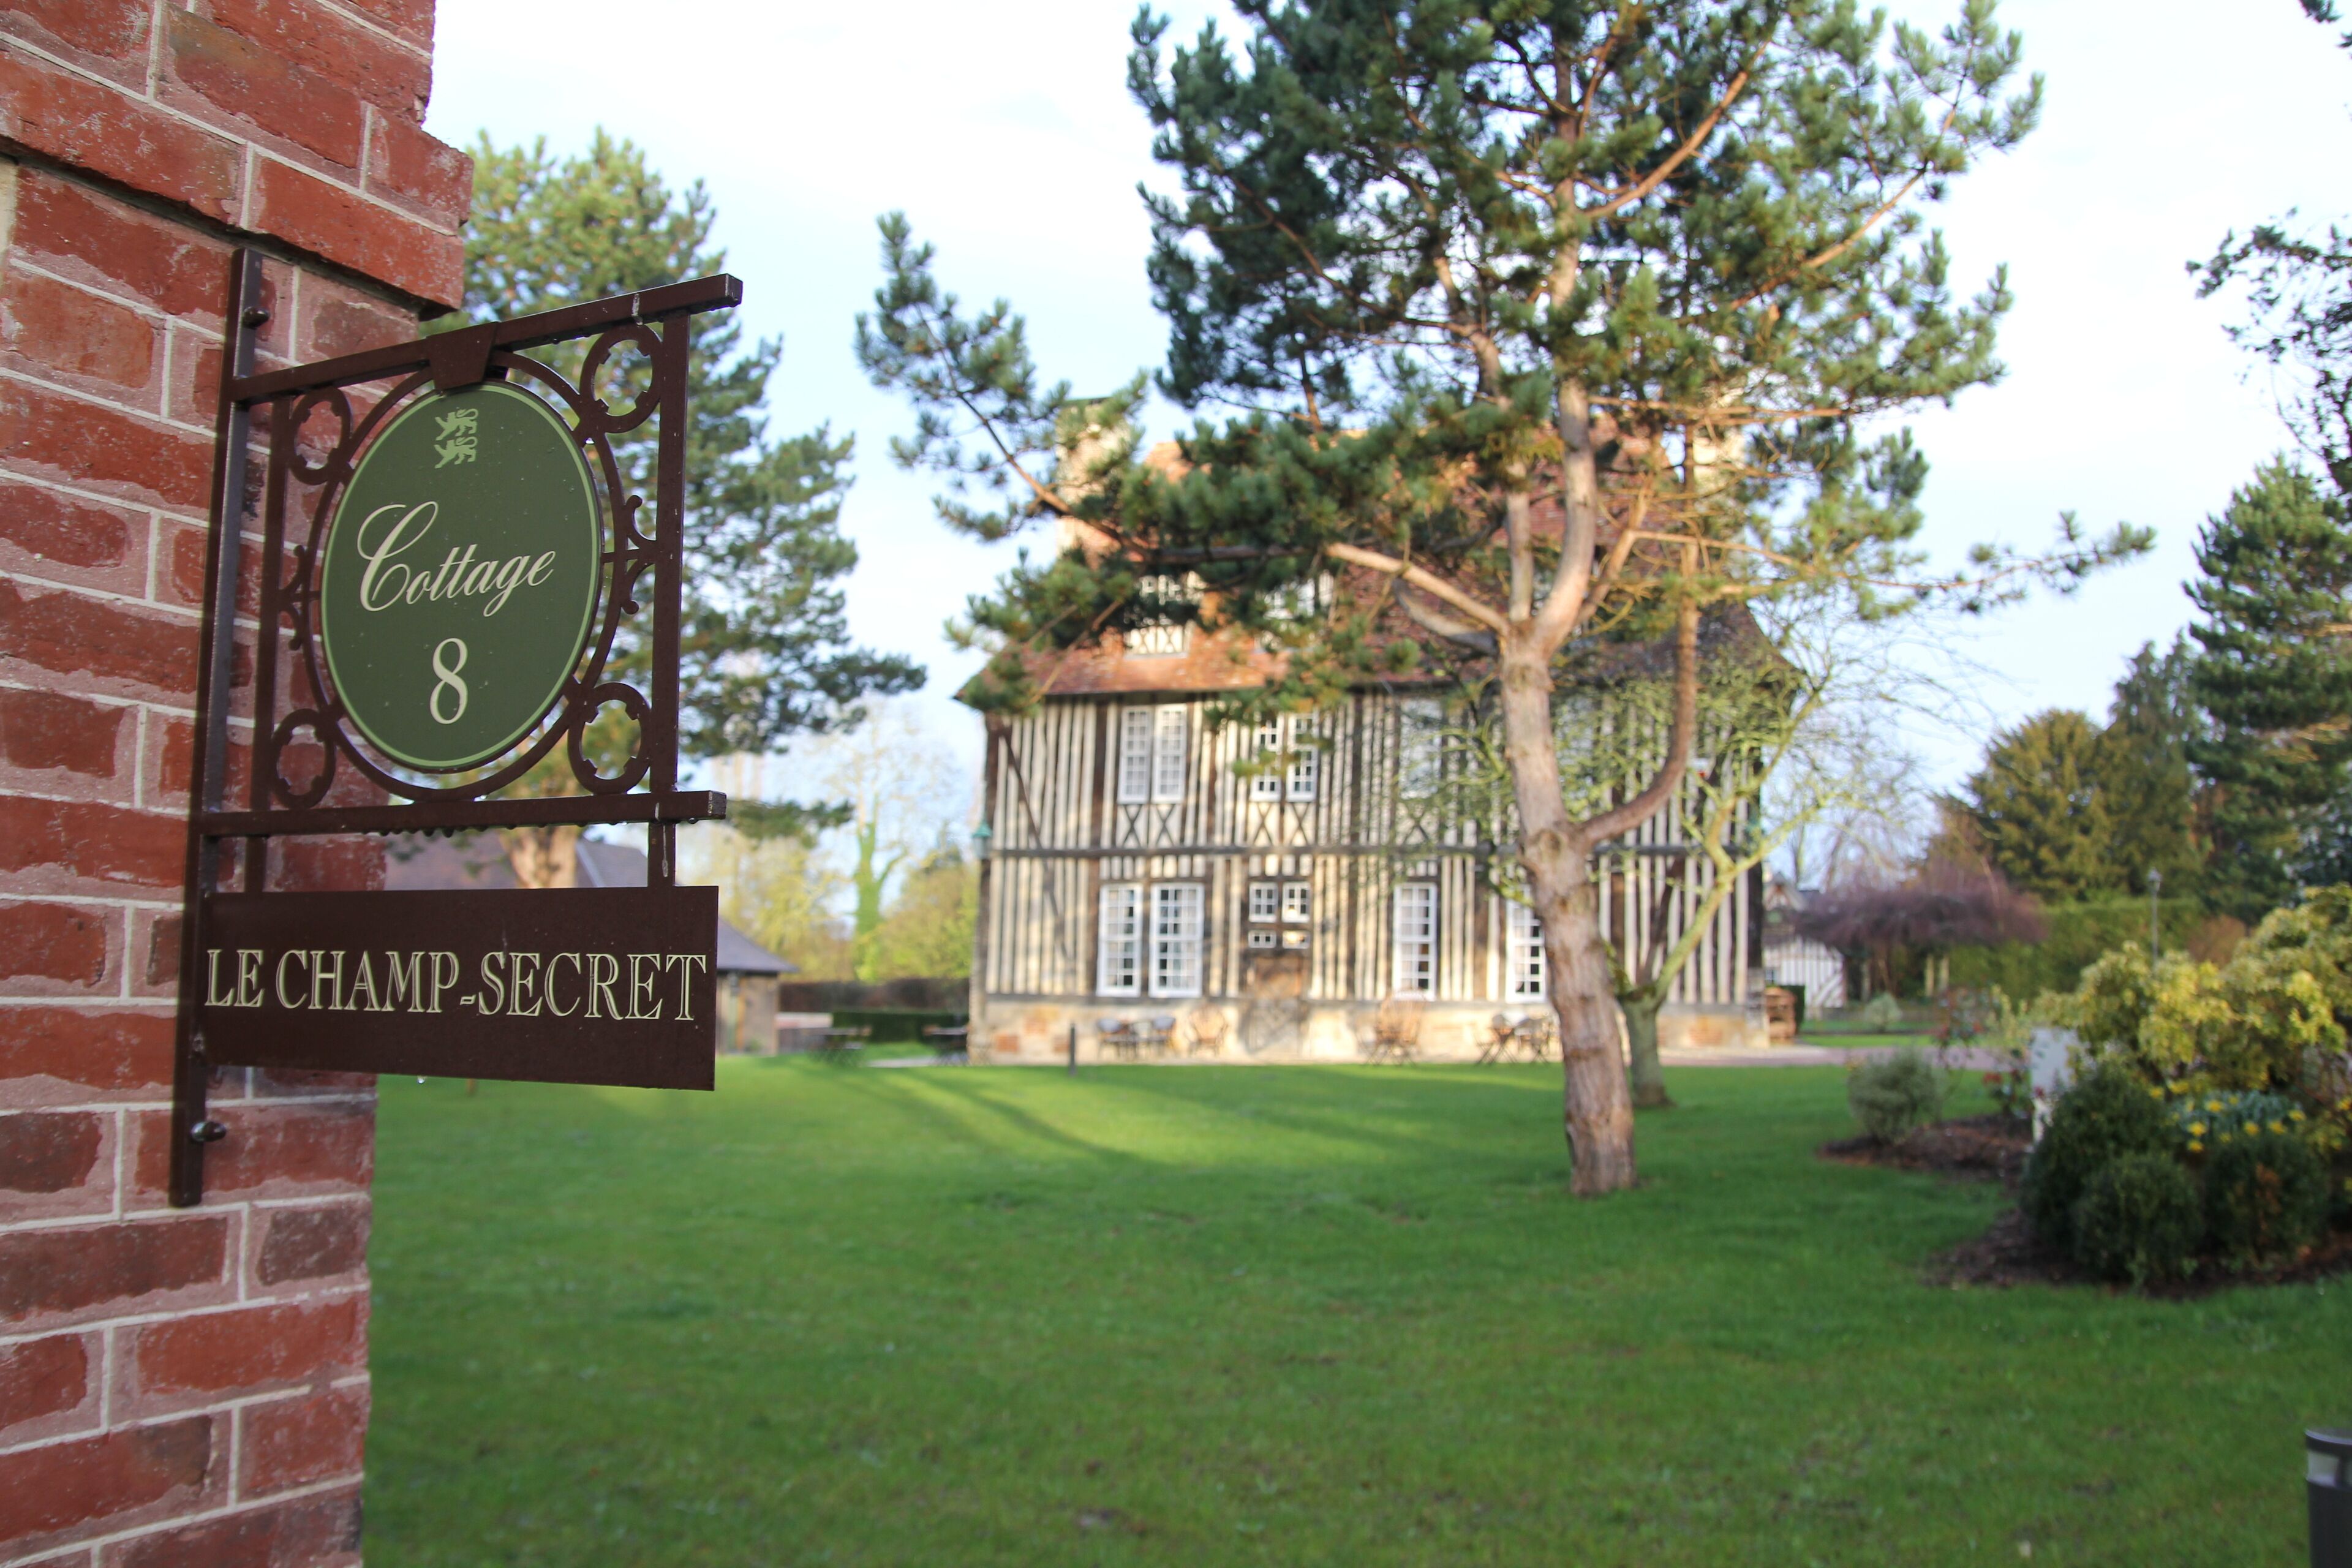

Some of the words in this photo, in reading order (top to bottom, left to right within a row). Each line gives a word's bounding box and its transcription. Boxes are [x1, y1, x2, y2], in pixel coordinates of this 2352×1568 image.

[356, 501, 556, 617] Cottage
[429, 637, 469, 725] 8
[204, 949, 265, 1008] LE
[276, 949, 707, 1022] CHAMP-SECRET
